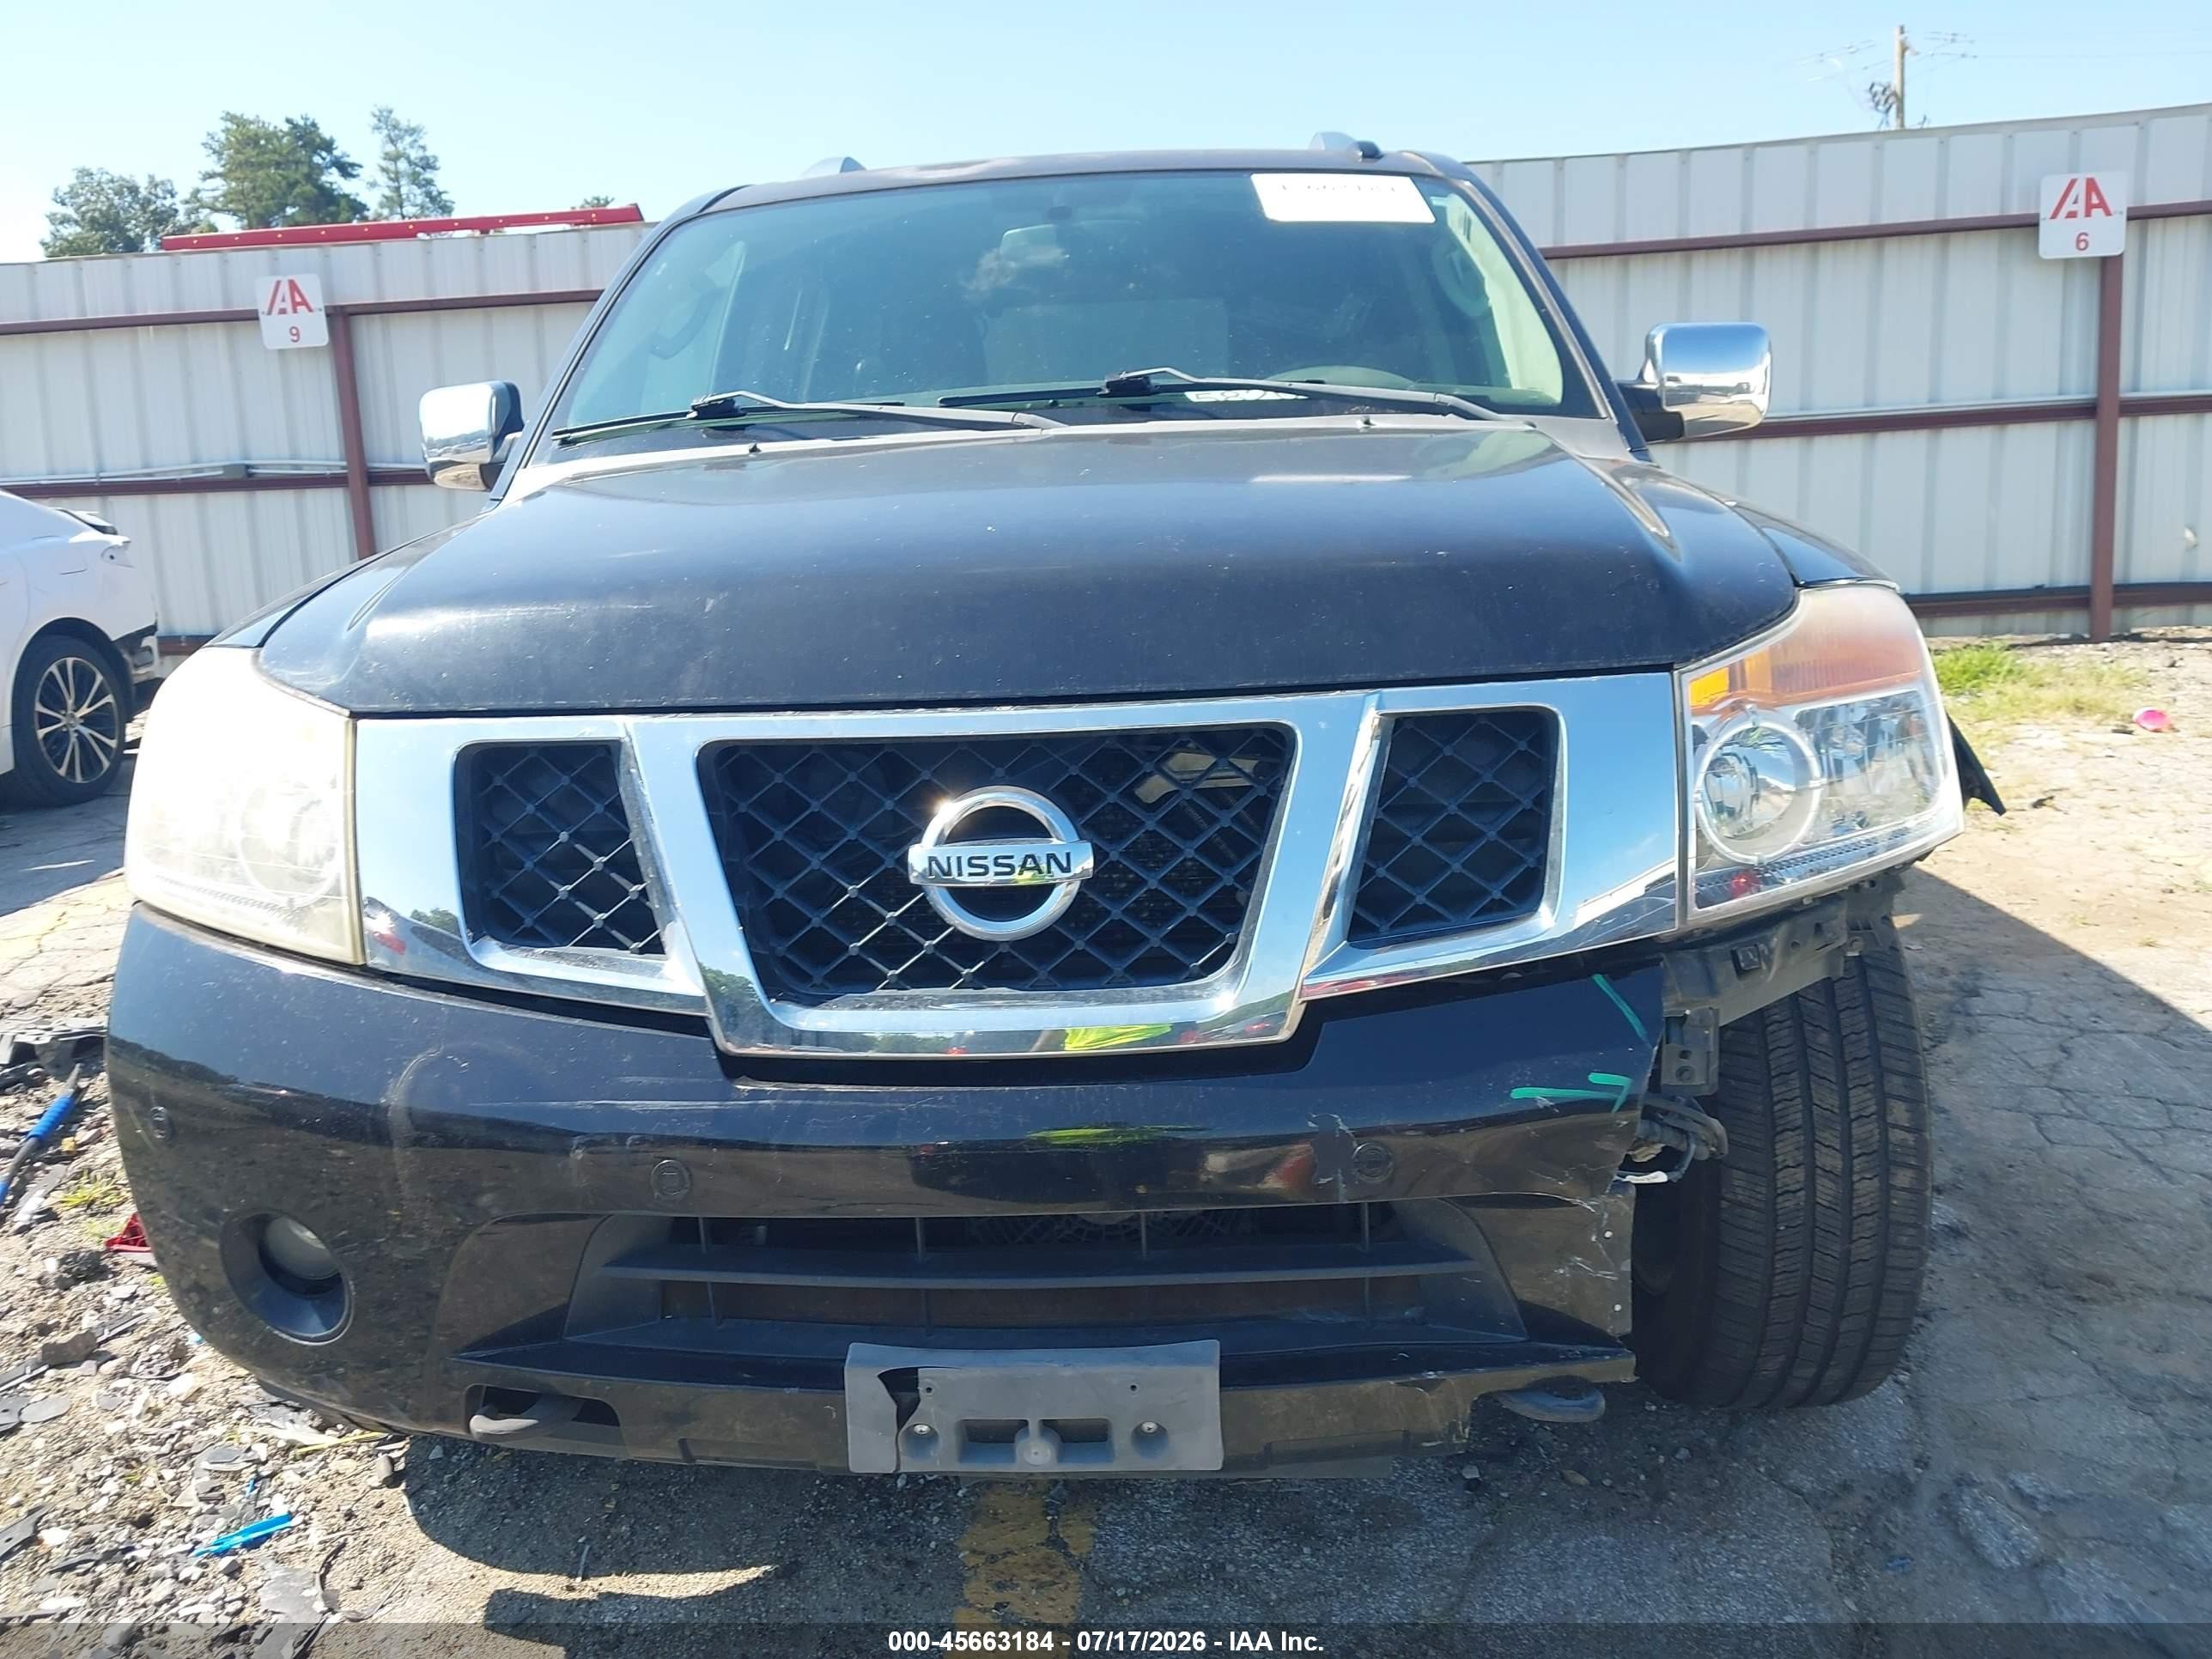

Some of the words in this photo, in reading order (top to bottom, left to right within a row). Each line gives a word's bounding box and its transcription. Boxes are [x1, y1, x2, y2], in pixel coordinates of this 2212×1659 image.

[2075, 232, 2089, 252] 6
[289, 325, 301, 343] 9
[927, 852, 1072, 878] NISSAN
